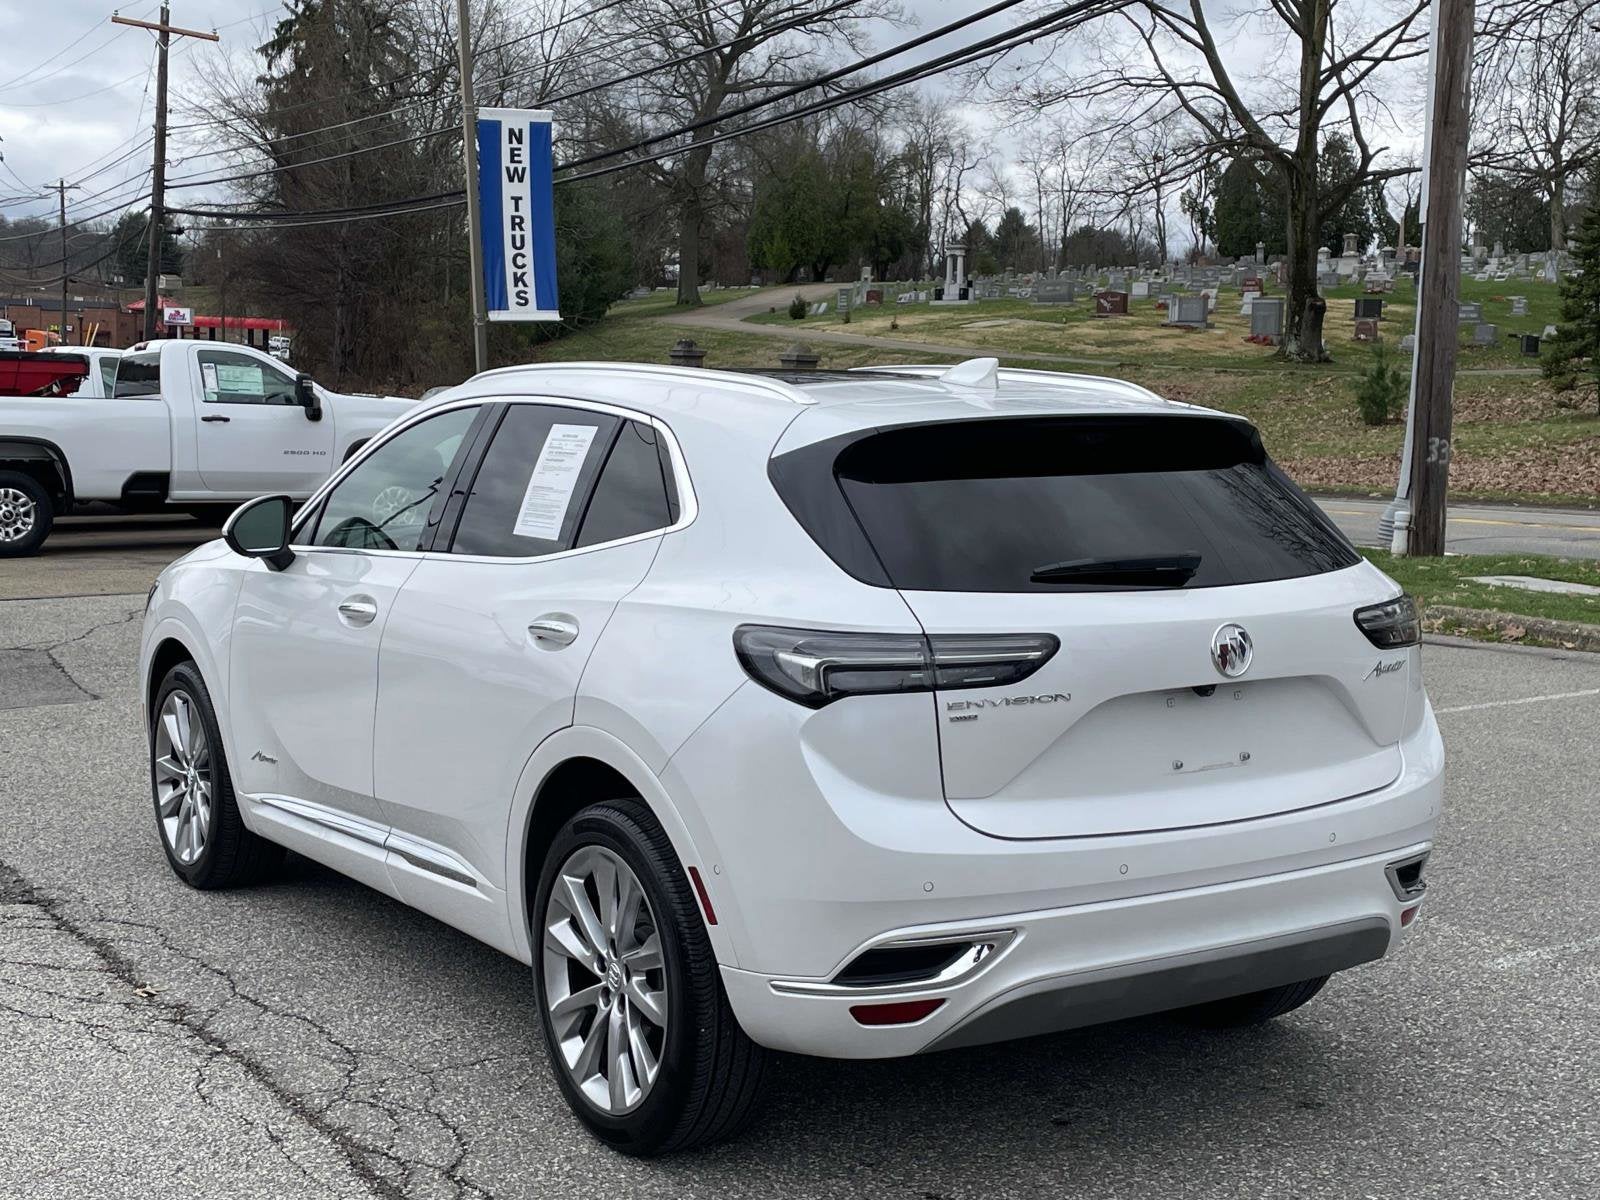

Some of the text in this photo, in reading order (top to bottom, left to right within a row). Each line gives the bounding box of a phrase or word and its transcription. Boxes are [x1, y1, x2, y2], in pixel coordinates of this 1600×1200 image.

[505, 127, 530, 307] NEW TRUCKS
[1426, 436, 1450, 464] 33
[946, 693, 1072, 711] ENVISION
